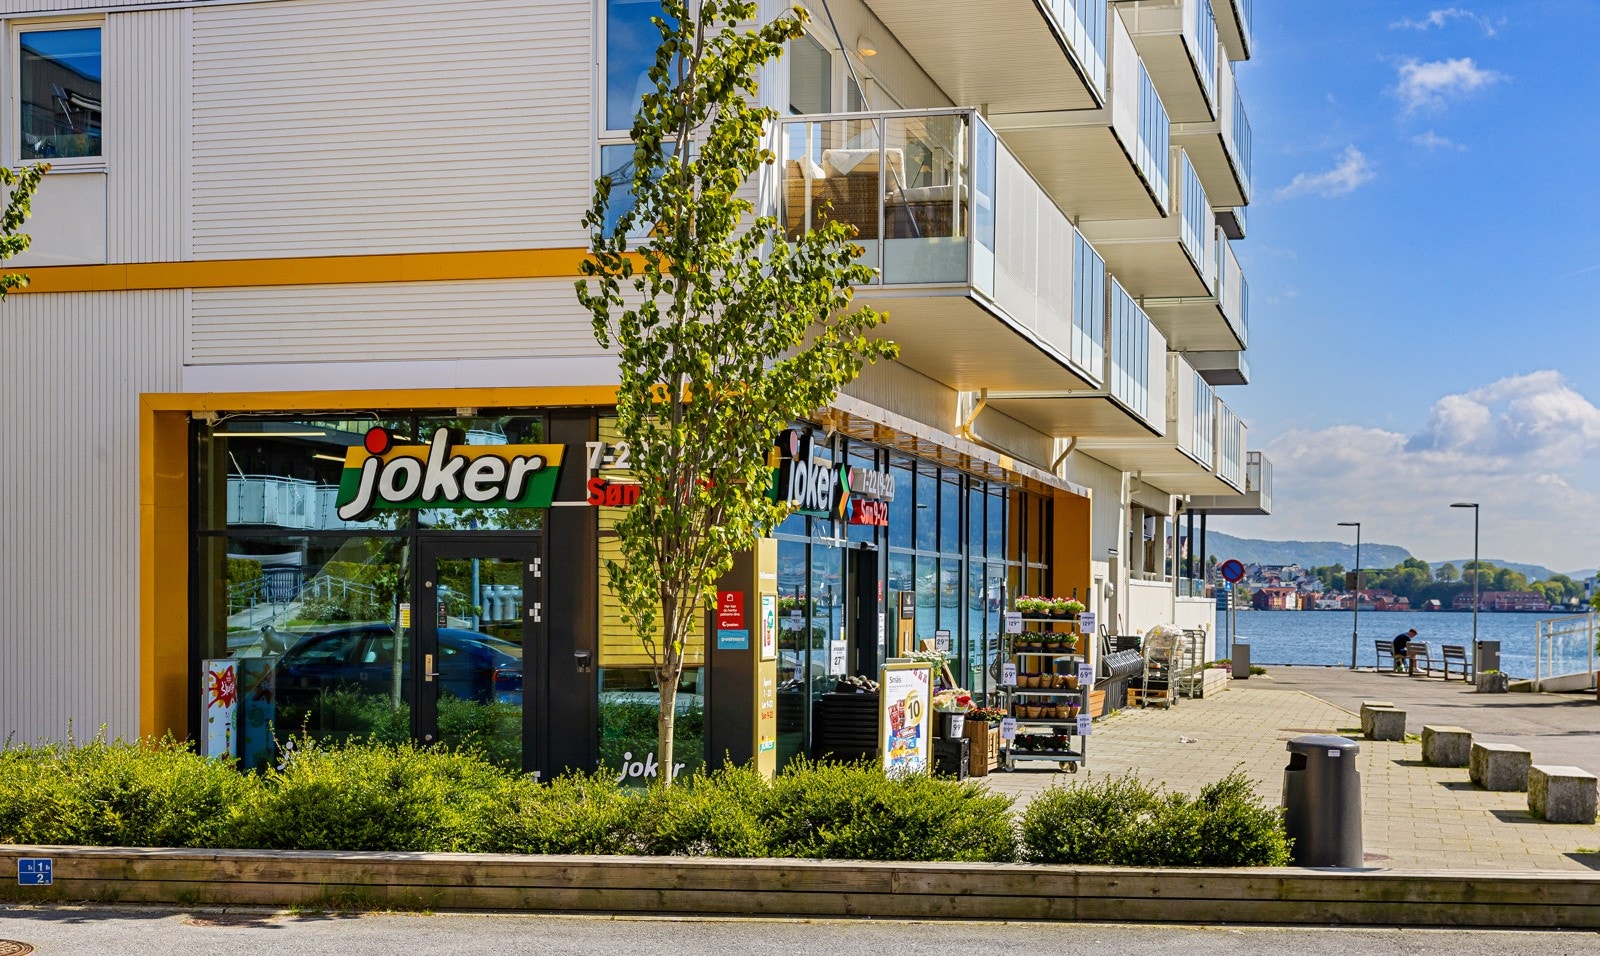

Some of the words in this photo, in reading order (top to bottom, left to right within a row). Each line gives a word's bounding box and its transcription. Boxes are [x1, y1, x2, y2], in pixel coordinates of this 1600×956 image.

[338, 426, 543, 520] joker
[786, 430, 839, 512] joker
[862, 468, 877, 493] 7-22
[587, 477, 640, 506] Søn
[874, 502, 888, 527] 9-22
[908, 700, 920, 719] 10
[614, 751, 685, 783] jokr
[37, 873, 44, 884] 2
[38, 862, 43, 872] 1
